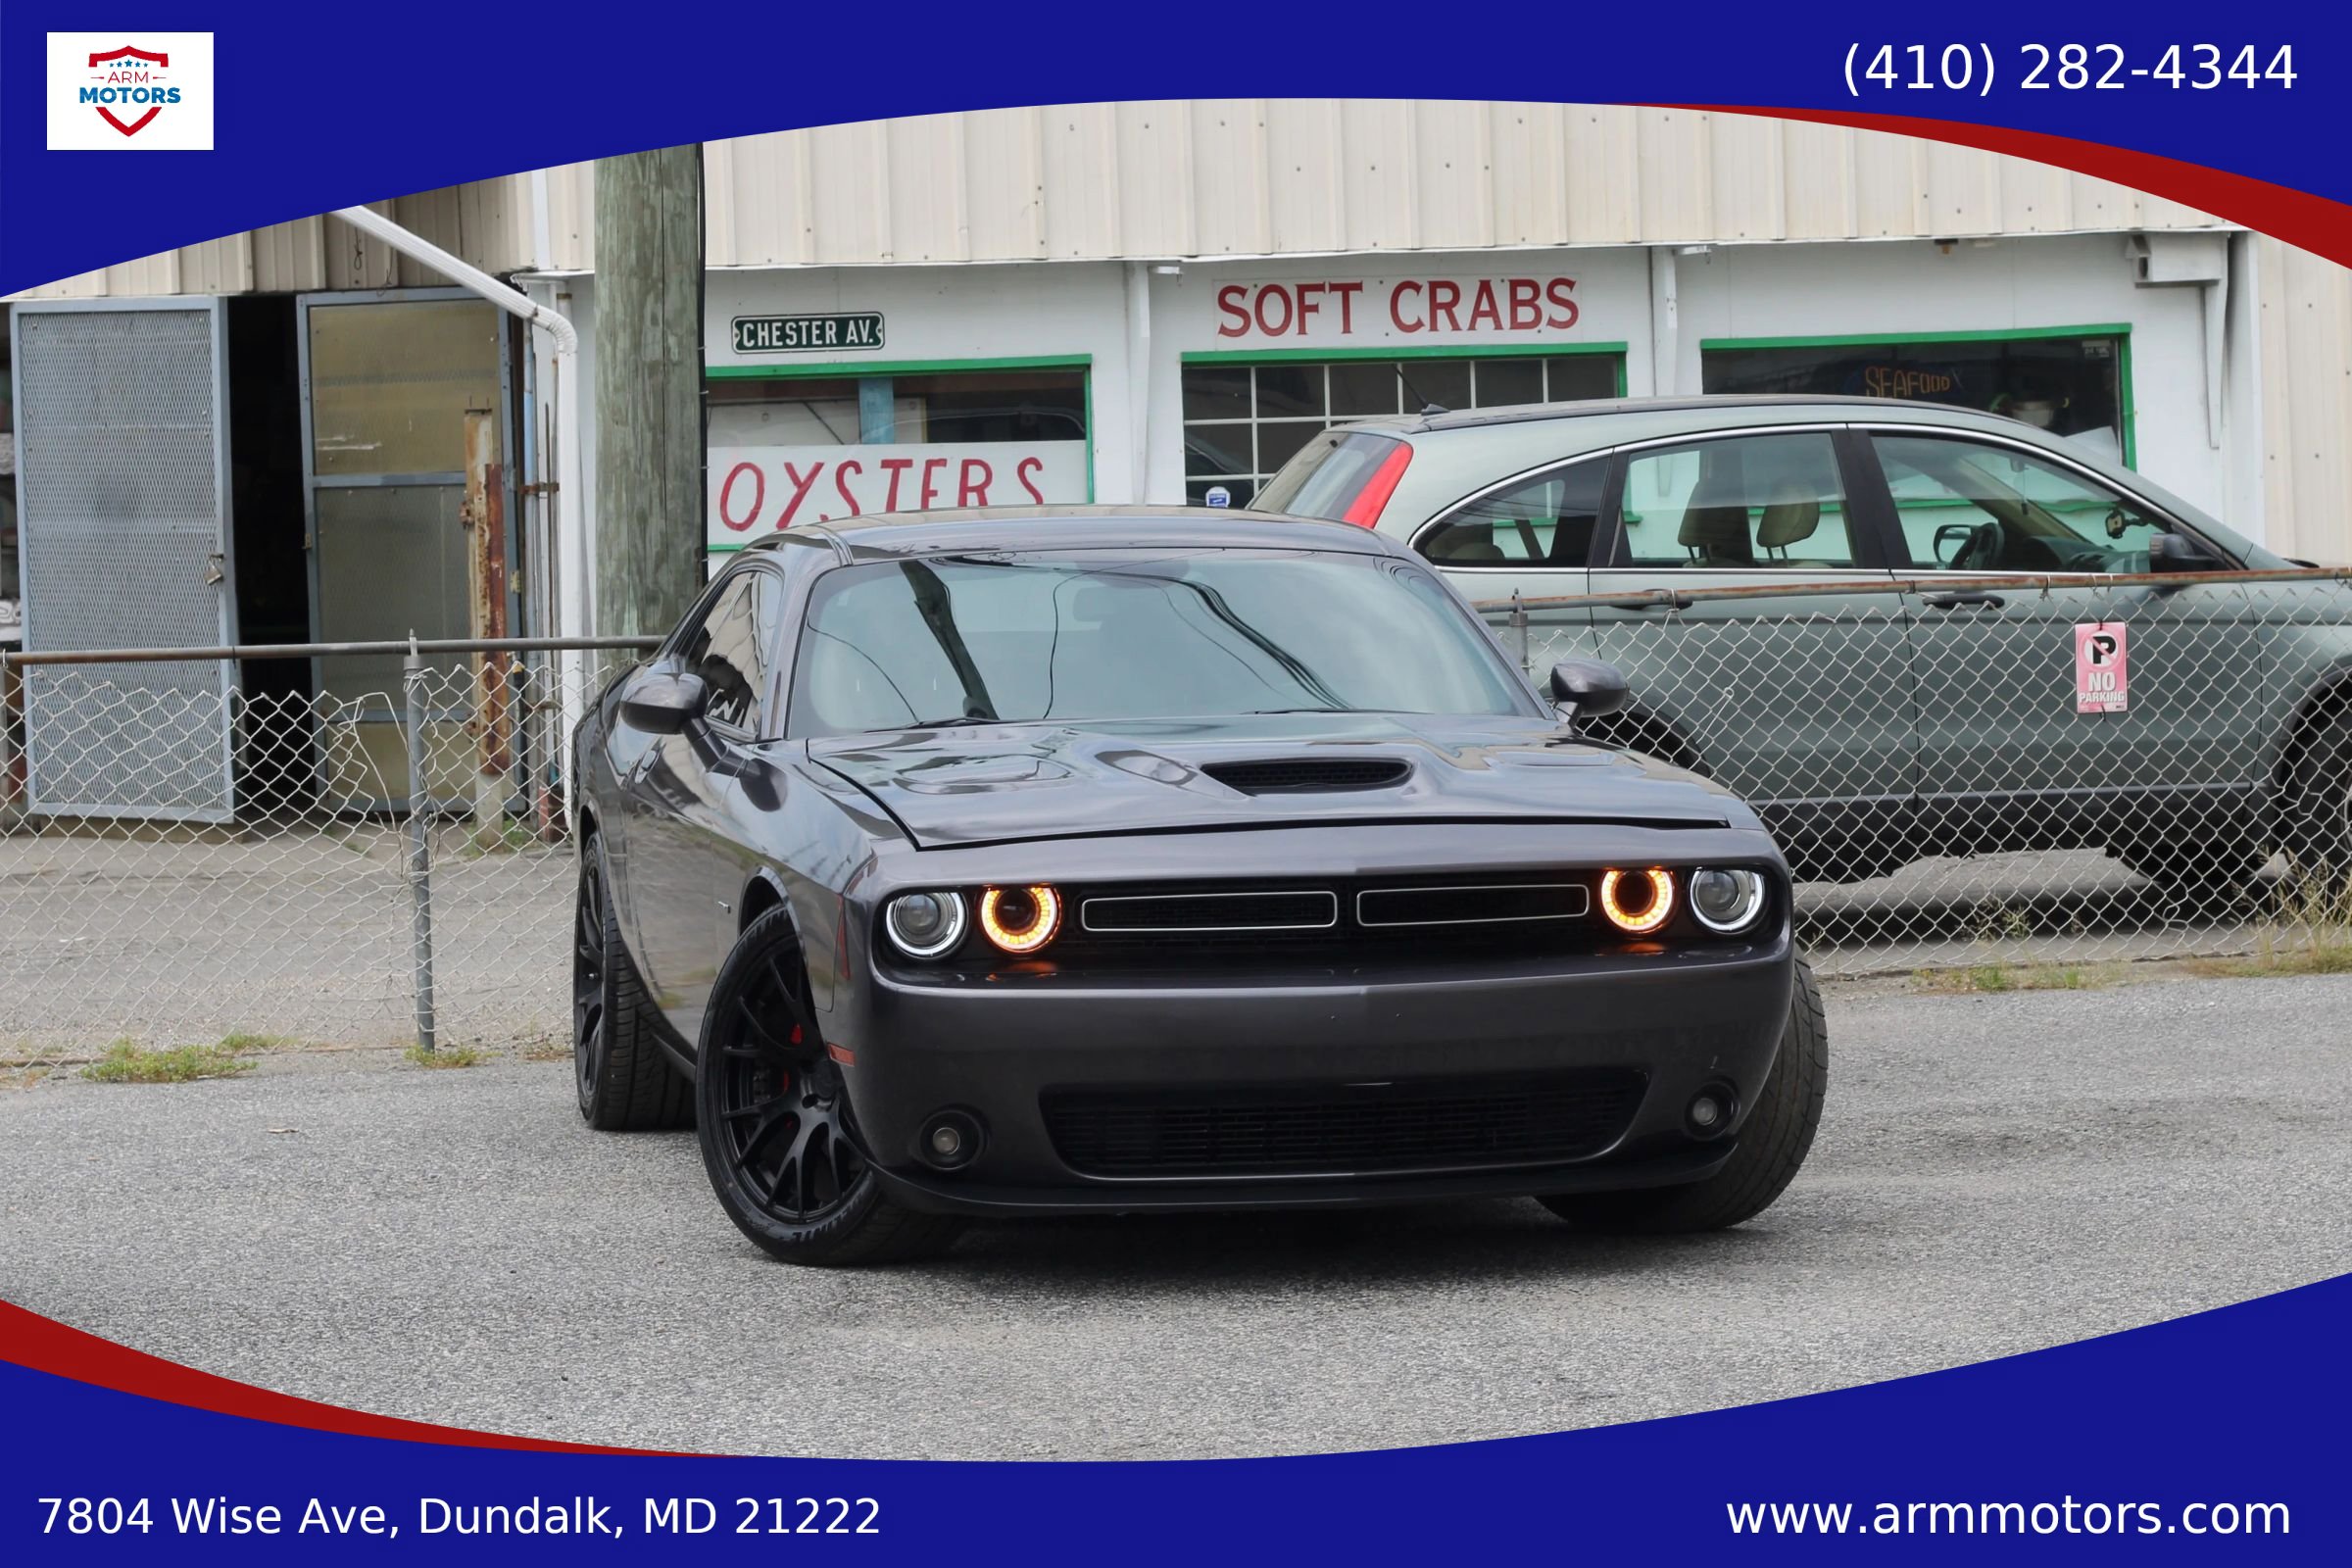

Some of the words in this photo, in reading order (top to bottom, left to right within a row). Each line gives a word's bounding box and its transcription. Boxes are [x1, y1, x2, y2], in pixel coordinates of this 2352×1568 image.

[1217, 279, 1363, 338] SOFT
[1390, 276, 1580, 334] CRABS
[742, 320, 837, 347] CHESTER
[846, 318, 874, 344] AV.
[1864, 365, 1951, 399] SEAFOOD
[719, 457, 1044, 532] OYSTERS
[2087, 671, 2116, 692] NO
[2079, 691, 2126, 704] PARKING
